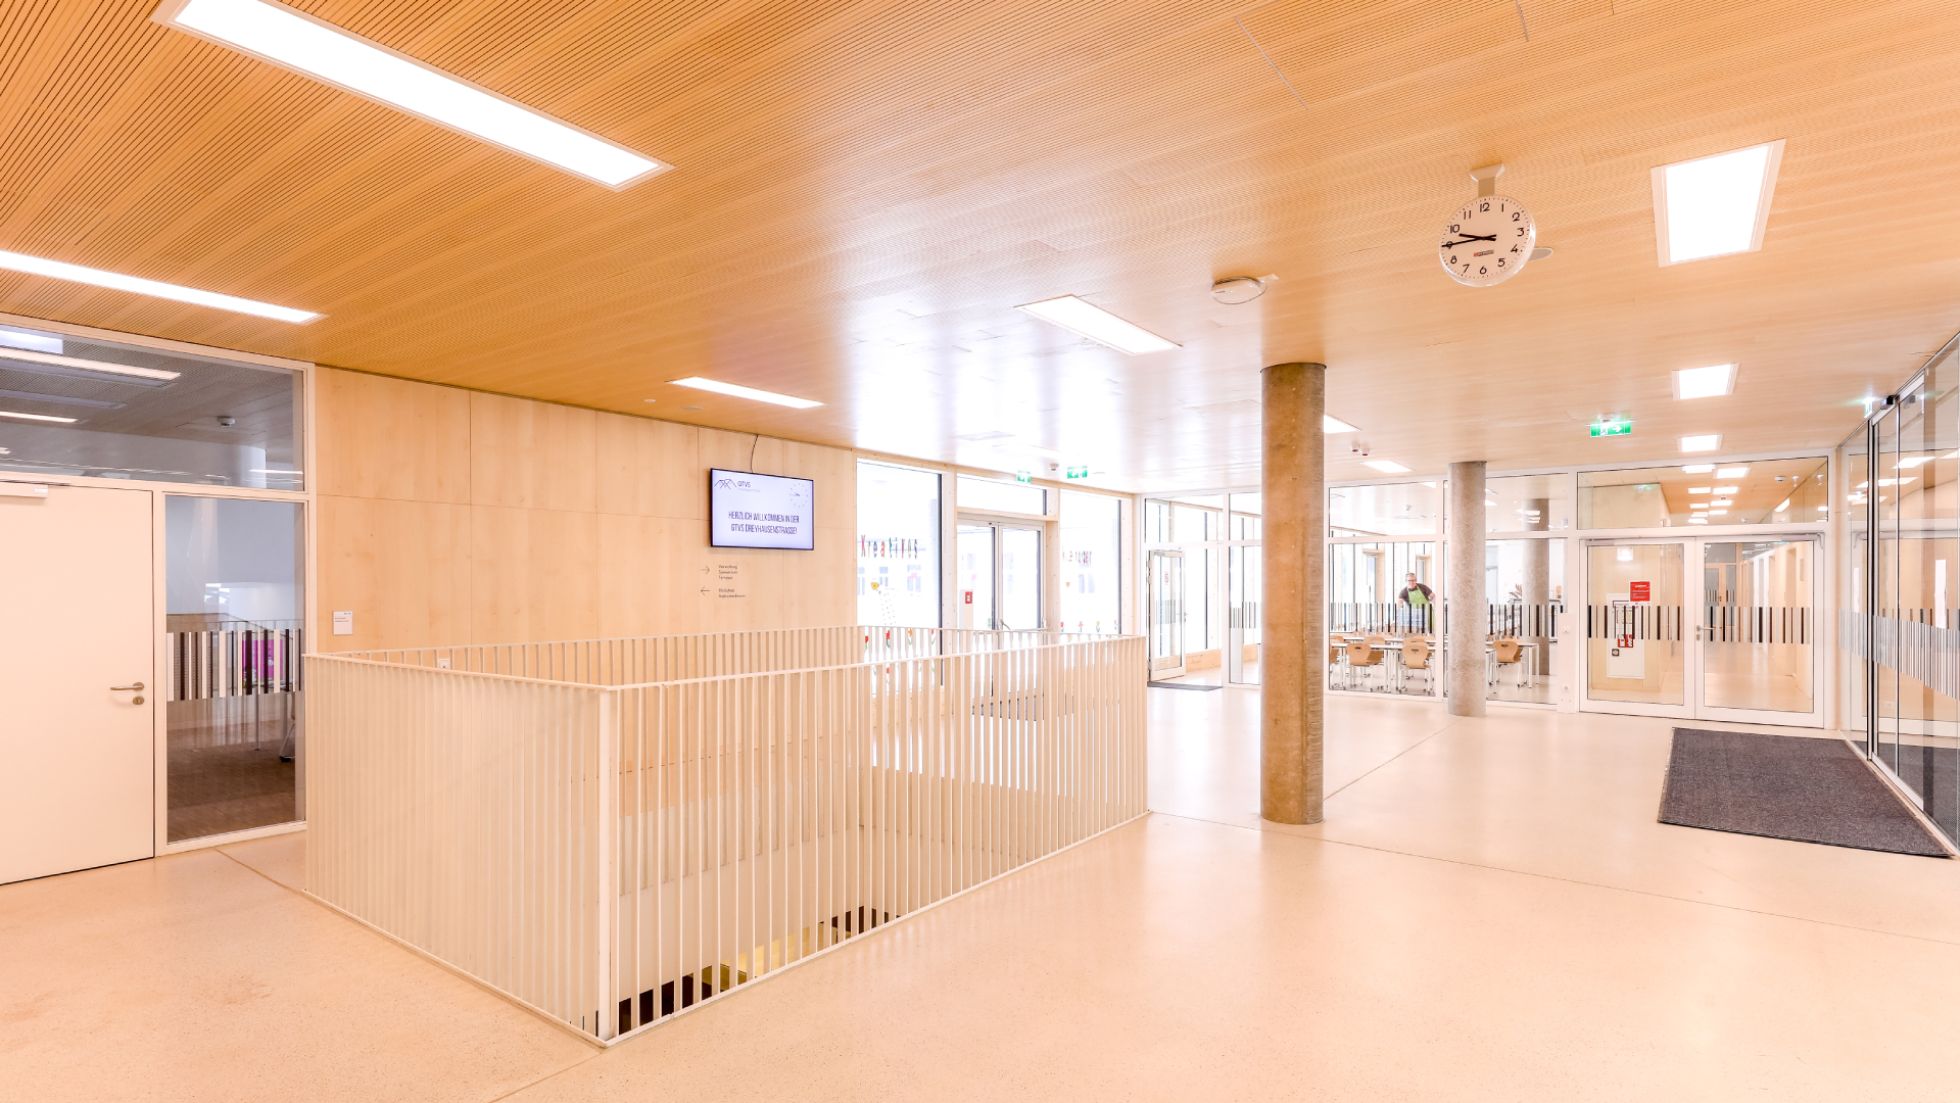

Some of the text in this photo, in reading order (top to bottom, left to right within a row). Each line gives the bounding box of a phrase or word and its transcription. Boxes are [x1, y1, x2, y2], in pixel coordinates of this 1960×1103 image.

[1479, 202, 1490, 213] 12
[1501, 203, 1505, 213] 1
[1463, 210, 1472, 220] 11
[1511, 212, 1520, 222] 2
[1449, 224, 1460, 234] 10
[1517, 227, 1525, 237] 3
[1510, 244, 1519, 253] 4
[1450, 255, 1458, 265] 8
[1497, 258, 1506, 268] 5
[1462, 263, 1470, 273] 7
[1479, 265, 1487, 275] 6
[728, 511, 753, 520] HERZLICH
[753, 512, 785, 523] WILLKOMMEN
